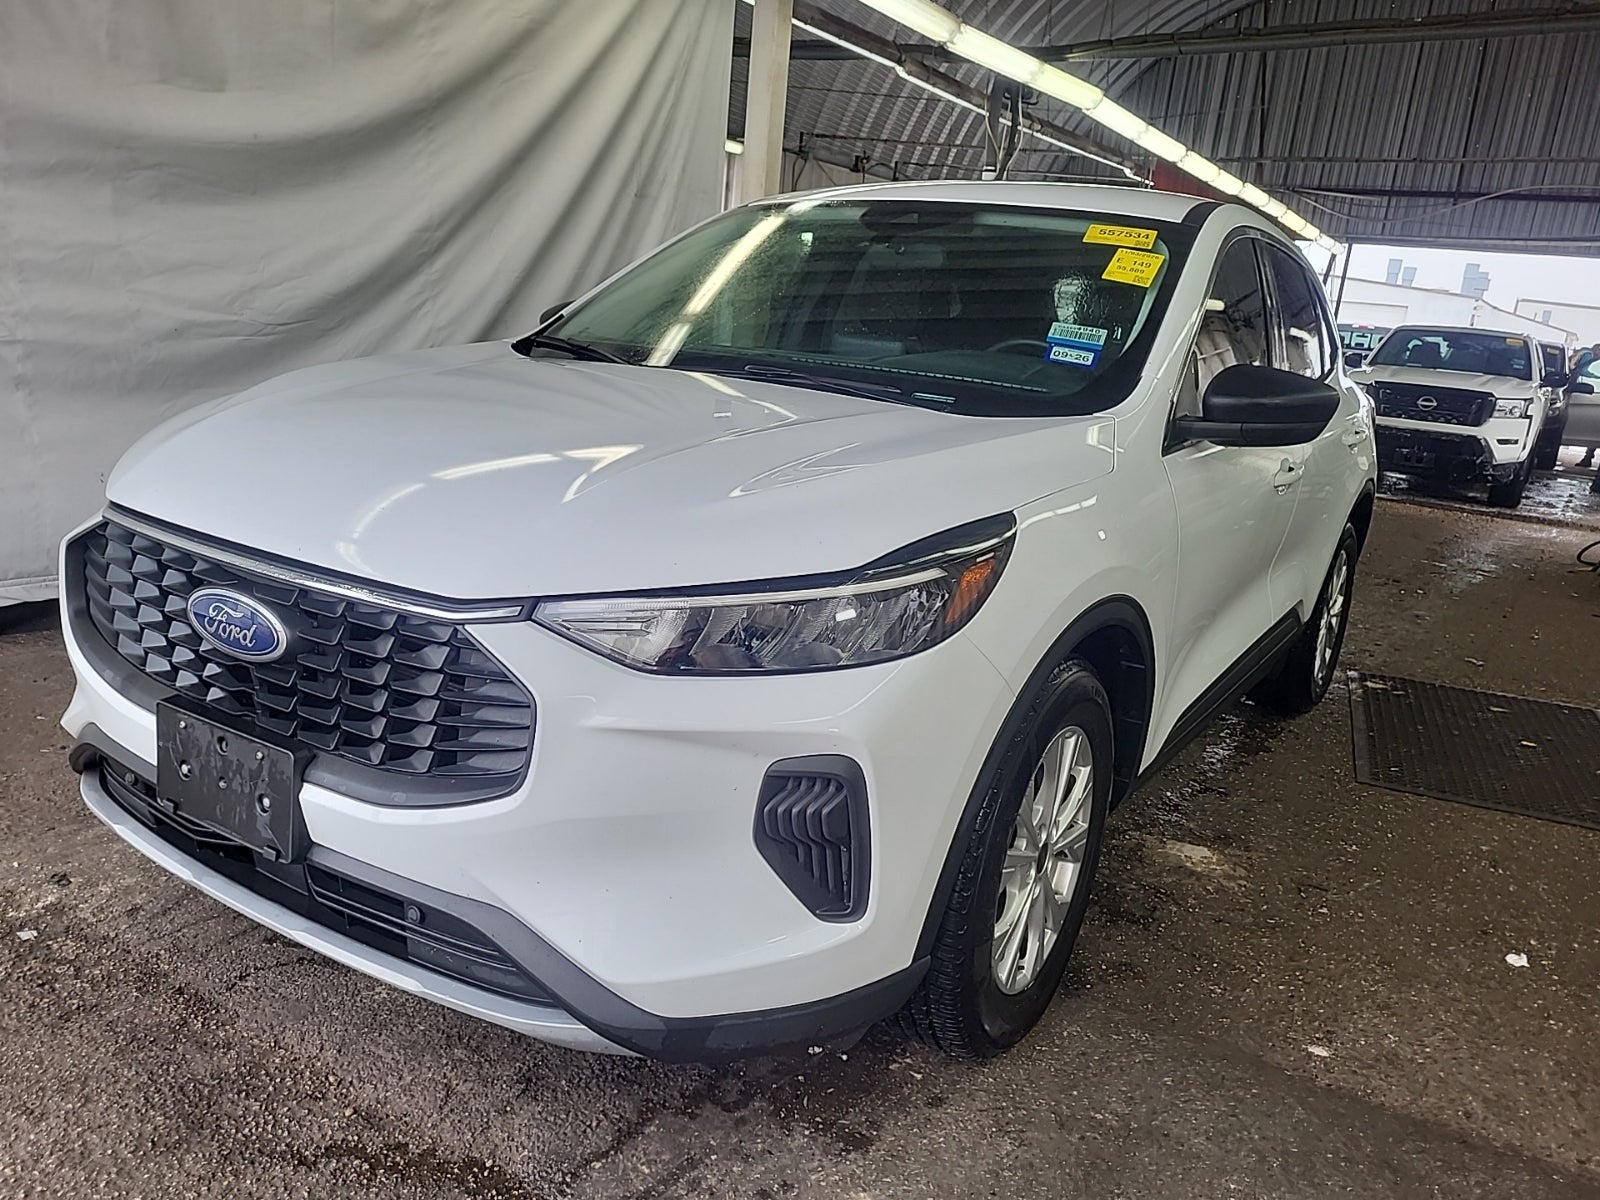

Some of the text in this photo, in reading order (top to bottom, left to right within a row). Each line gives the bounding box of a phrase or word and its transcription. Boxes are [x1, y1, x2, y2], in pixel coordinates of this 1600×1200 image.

[1098, 228, 1150, 240] 557534
[1132, 260, 1152, 268] 149
[204, 602, 258, 648] Ford
